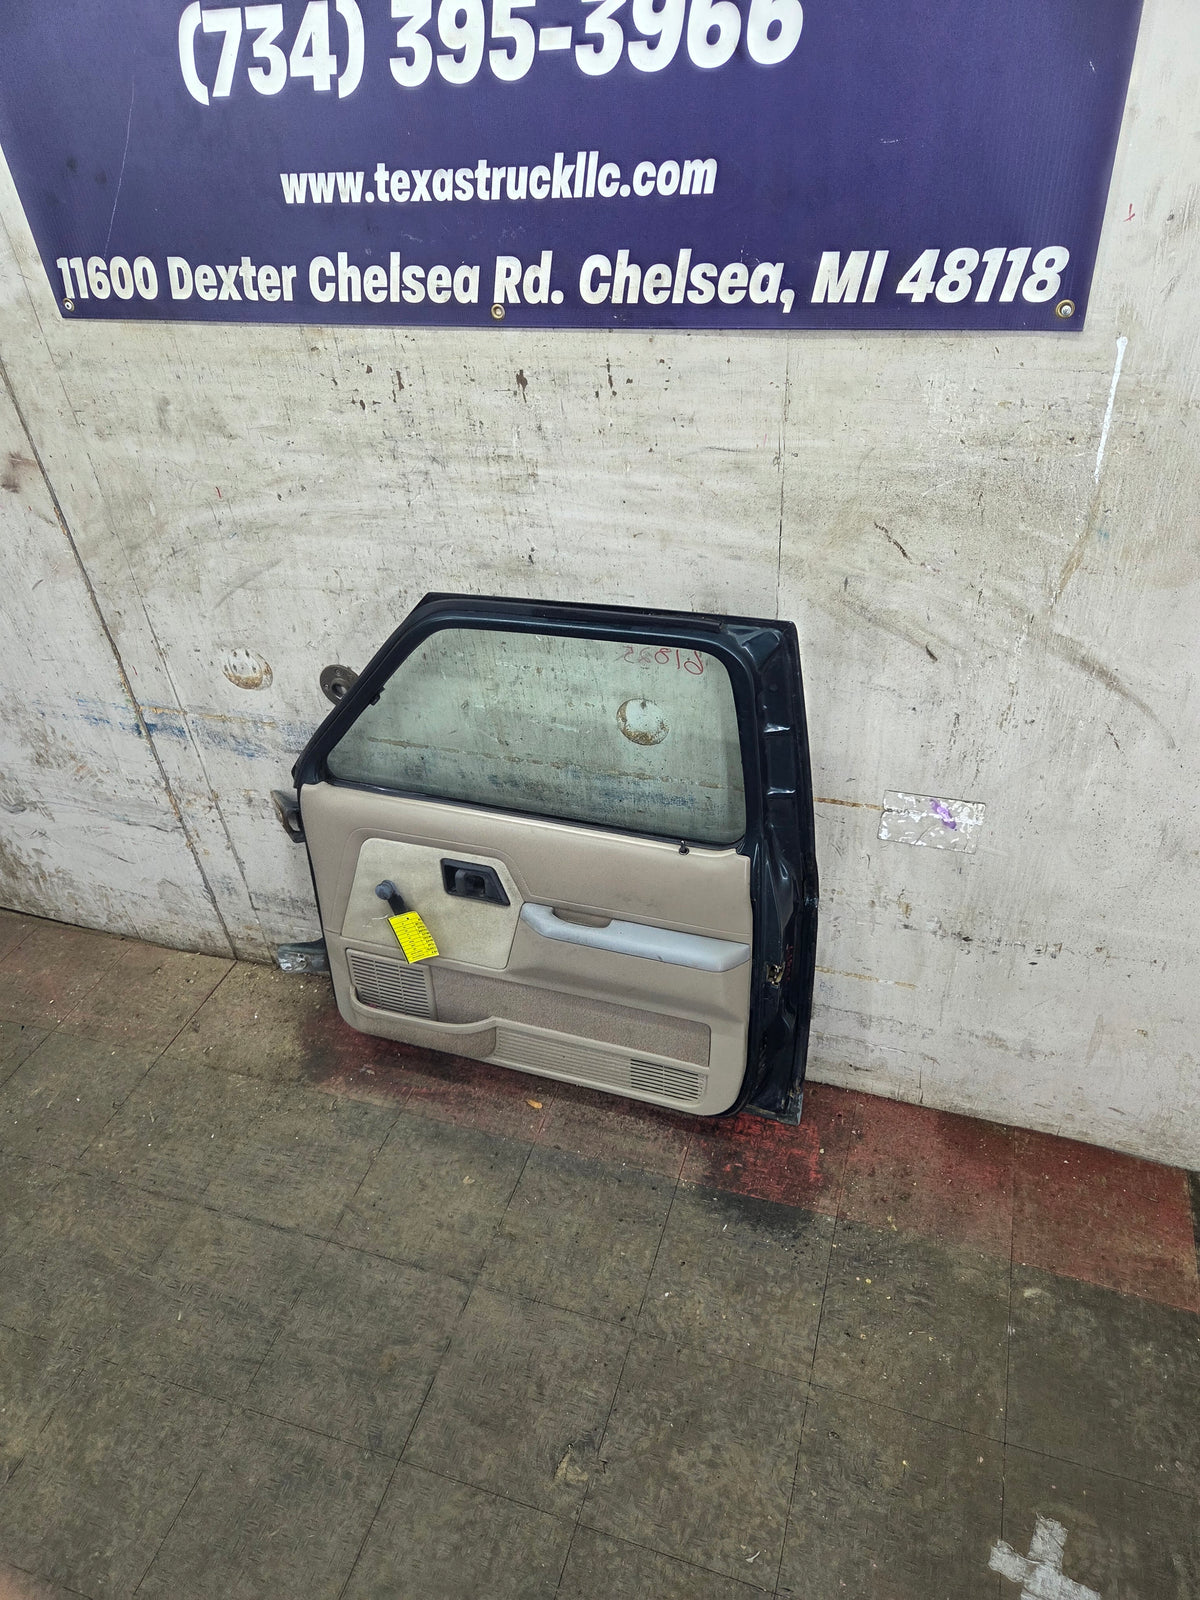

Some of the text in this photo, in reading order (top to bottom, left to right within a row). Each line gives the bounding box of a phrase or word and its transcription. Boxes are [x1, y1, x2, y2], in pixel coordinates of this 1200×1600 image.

[179, 0, 805, 105] (734) 395-3966
[280, 151, 717, 205] www.texastruckllc.com
[57, 246, 1069, 314] 11600 Dexter Chelsea Rd. Chelsea, MI 48118
